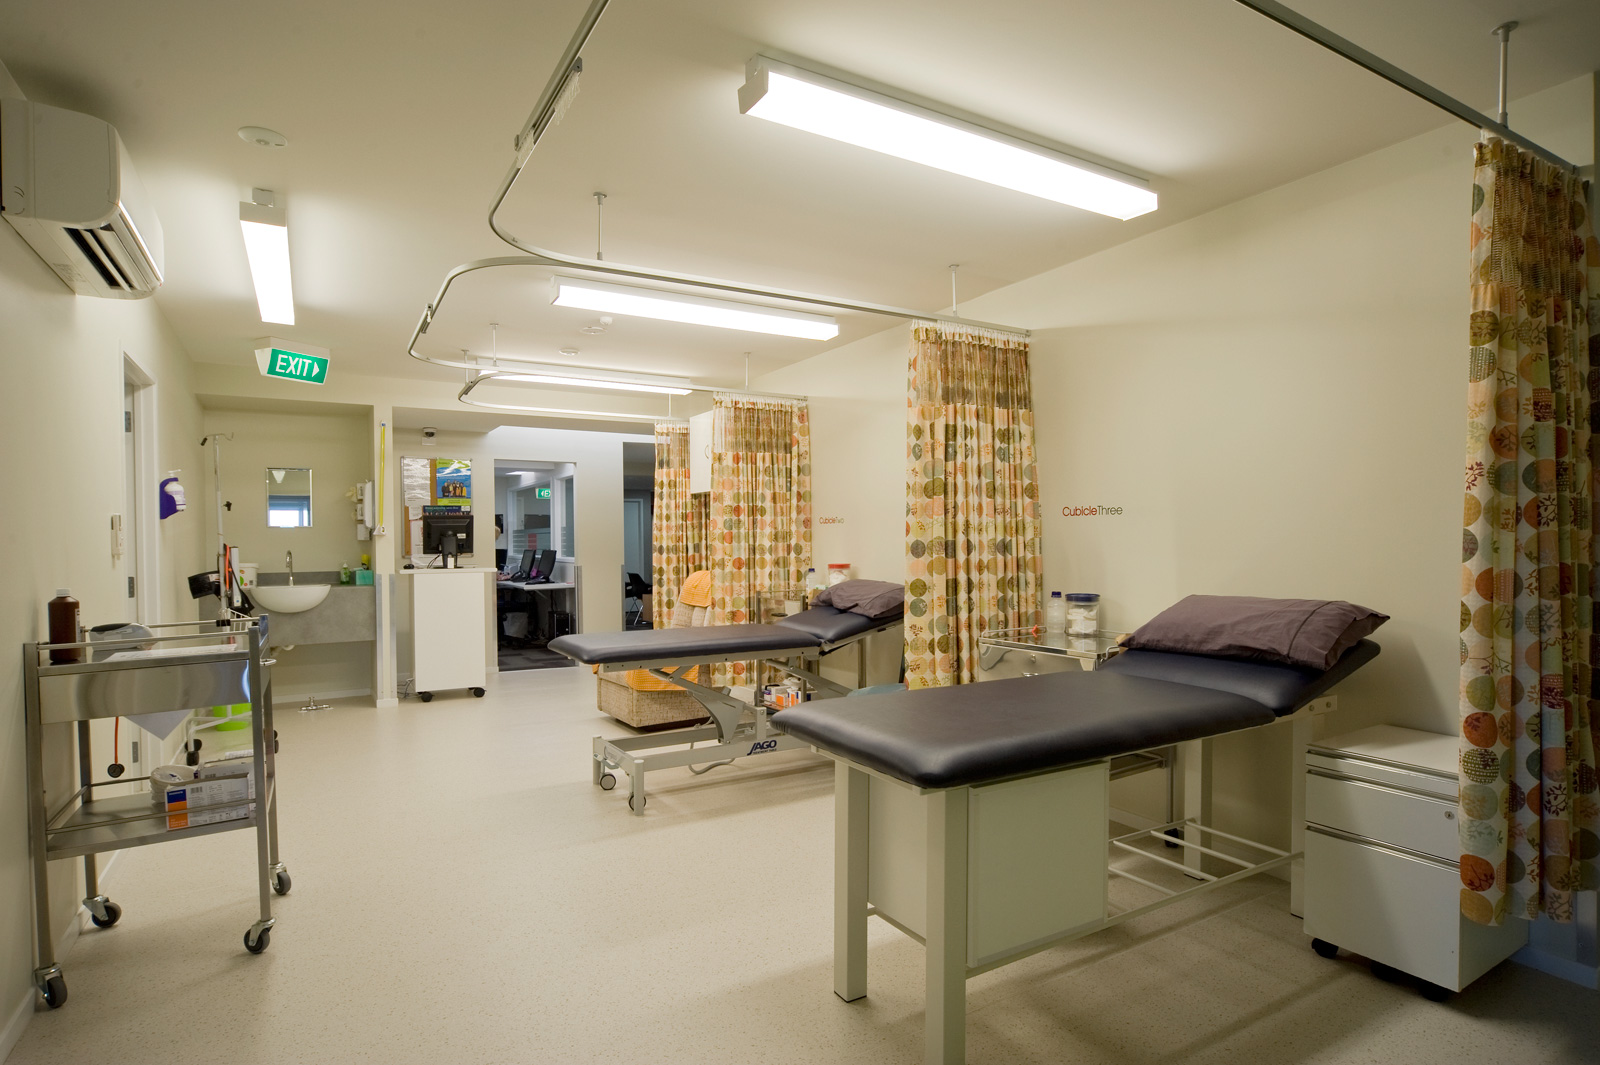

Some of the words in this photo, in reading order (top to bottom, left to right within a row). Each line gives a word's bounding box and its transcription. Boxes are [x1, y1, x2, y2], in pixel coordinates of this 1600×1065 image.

[275, 354, 312, 377] EXIT
[1062, 505, 1123, 517] CubicleThree
[747, 739, 777, 756] JAGO
